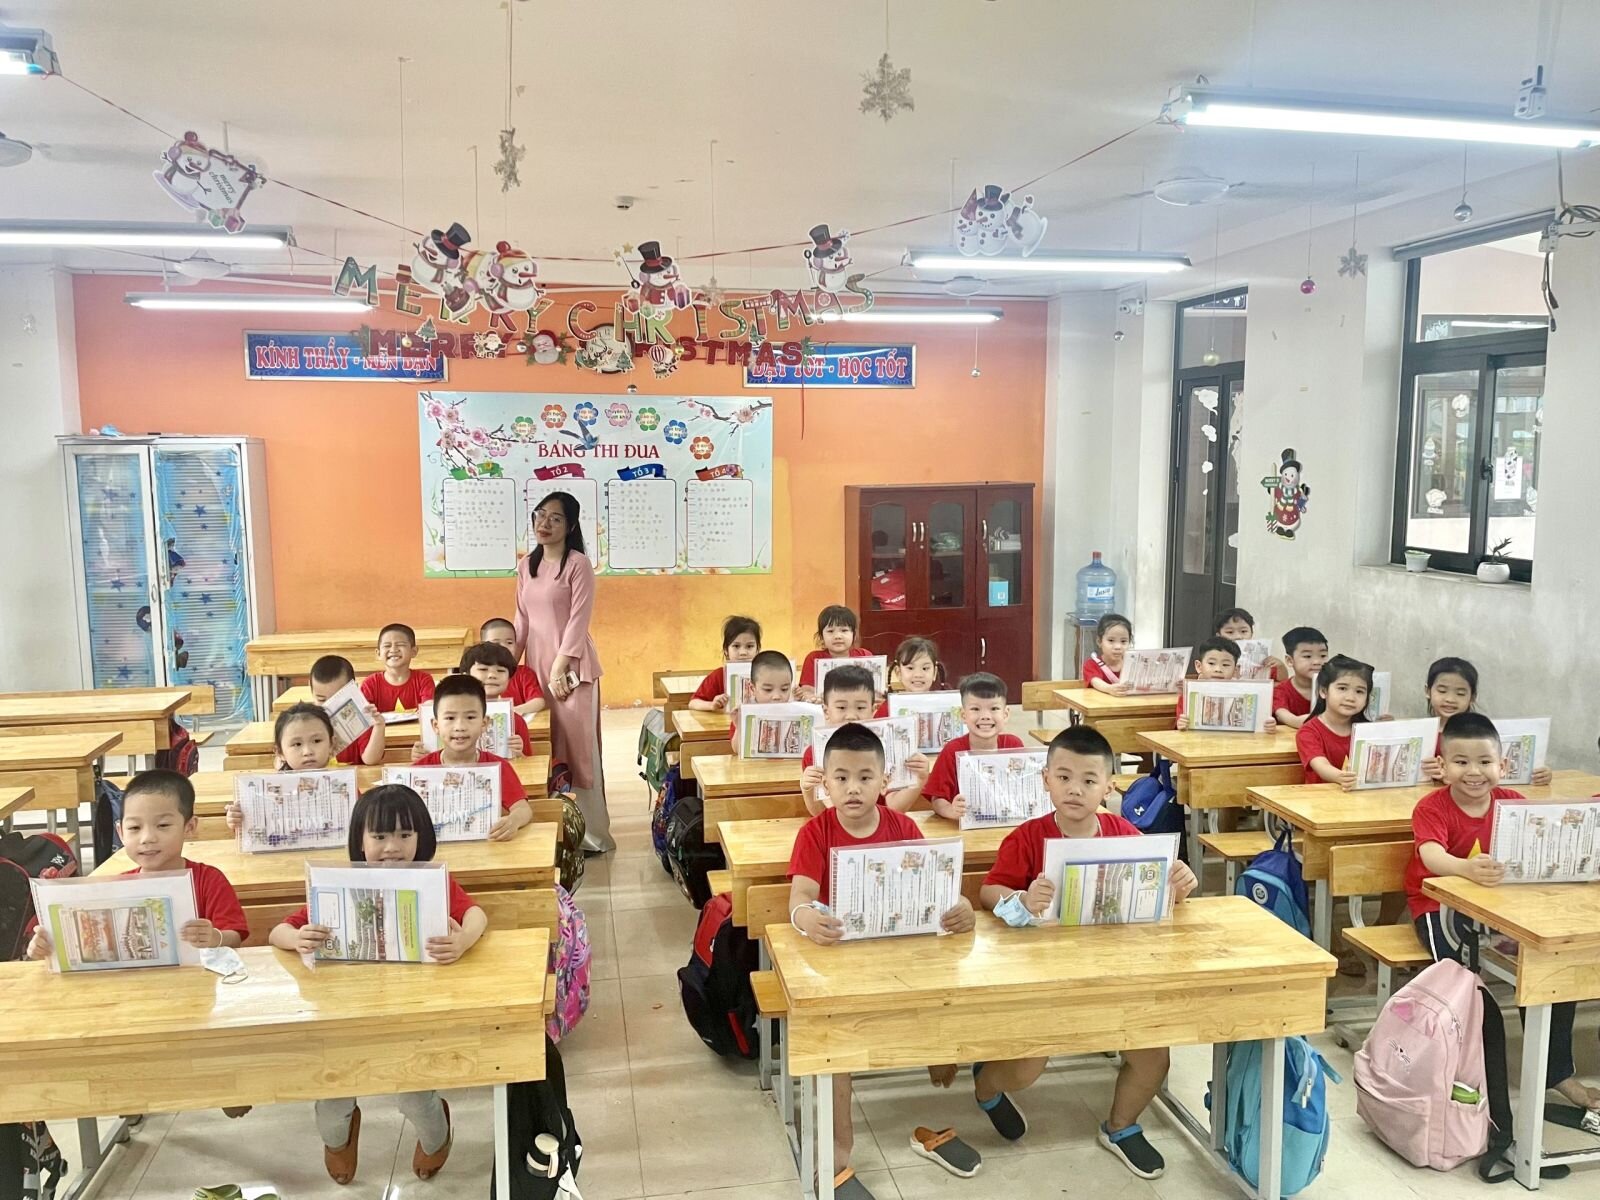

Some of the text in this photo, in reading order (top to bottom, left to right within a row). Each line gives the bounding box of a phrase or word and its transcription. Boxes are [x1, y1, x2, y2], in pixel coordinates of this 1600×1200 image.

[333, 256, 555, 334] MEY
[255, 340, 300, 369] KÍNH
[303, 337, 350, 369] THẦY
[837, 357, 872, 383] HỌC
[875, 348, 908, 378] TỐT
[593, 444, 619, 458] THI
[624, 444, 660, 459] ĐUA
